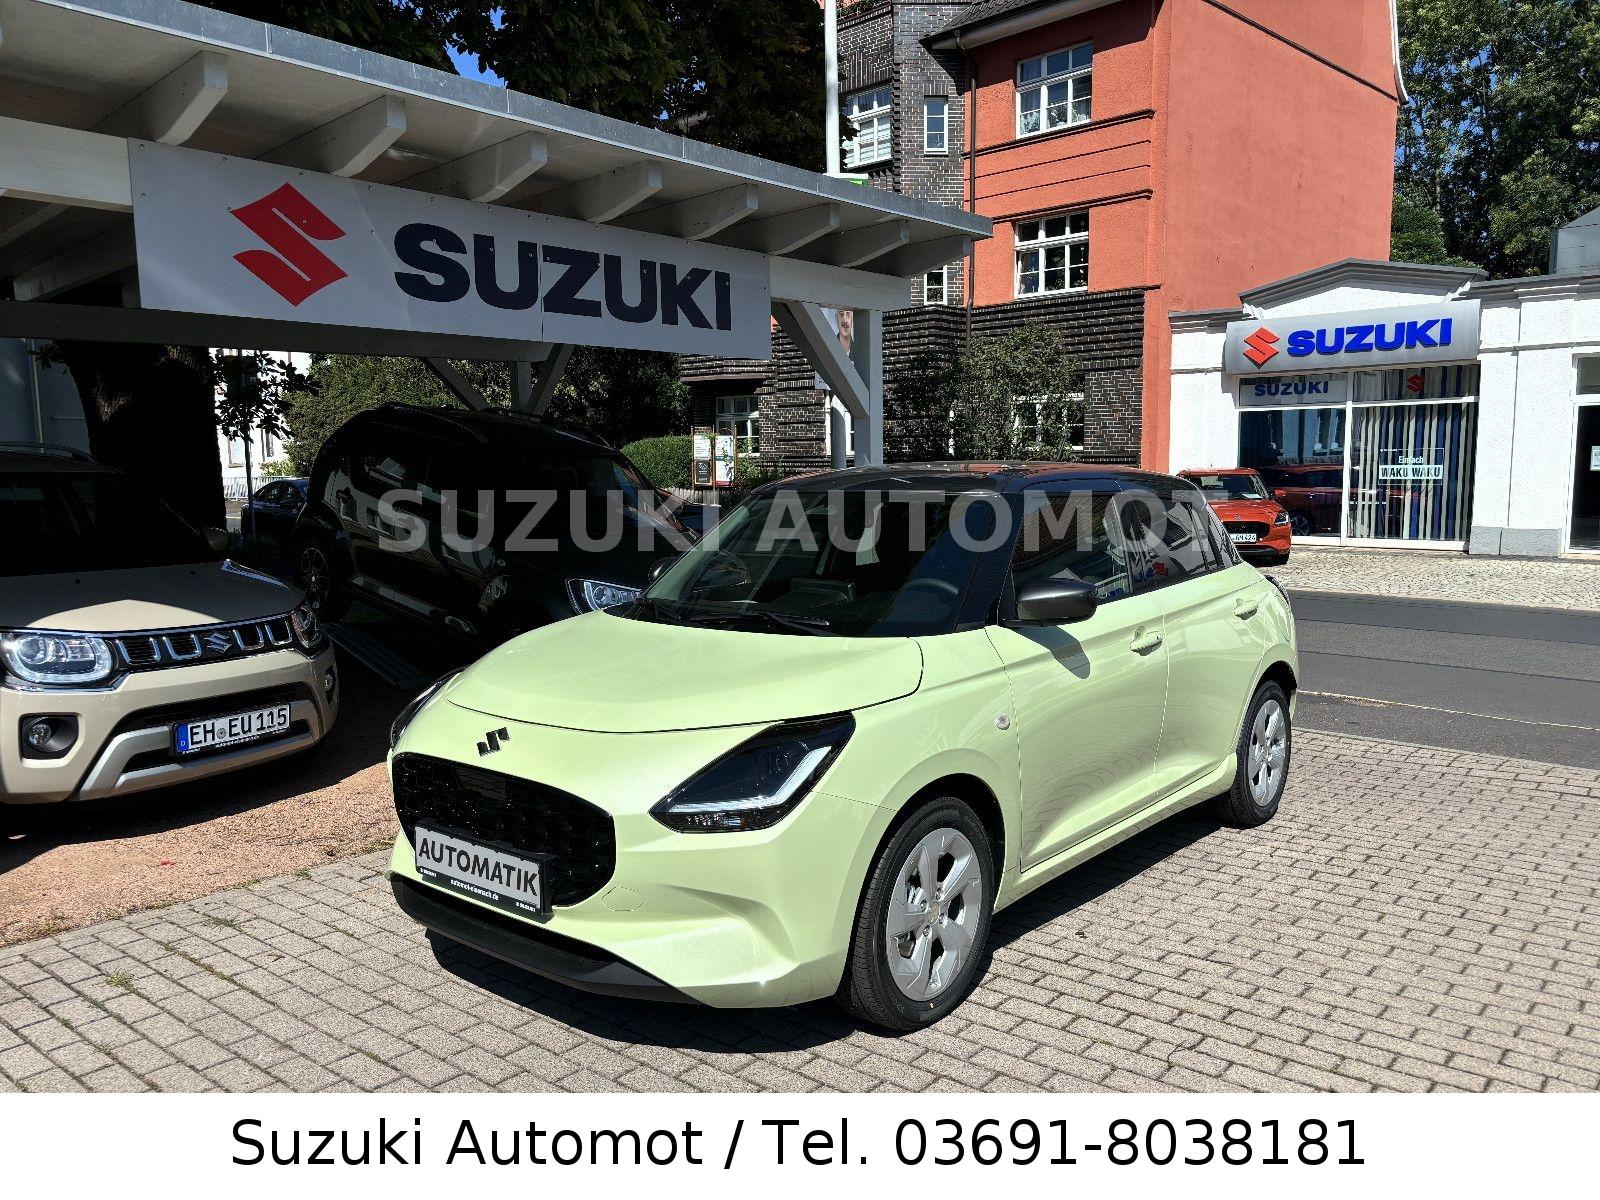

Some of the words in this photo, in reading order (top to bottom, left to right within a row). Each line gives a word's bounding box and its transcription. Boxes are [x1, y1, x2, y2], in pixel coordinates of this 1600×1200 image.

[394, 222, 732, 331] SUZUKI
[1286, 317, 1453, 358] SUZUKI
[1254, 380, 1330, 397] SUZUKI
[1381, 467, 1409, 478] WAKU
[1412, 466, 1441, 478] WAKU
[1398, 455, 1424, 464] Einfach
[189, 721, 216, 746] EH
[228, 714, 252, 738] EU
[255, 707, 288, 732] 115
[418, 837, 538, 897] AUTOMATIK
